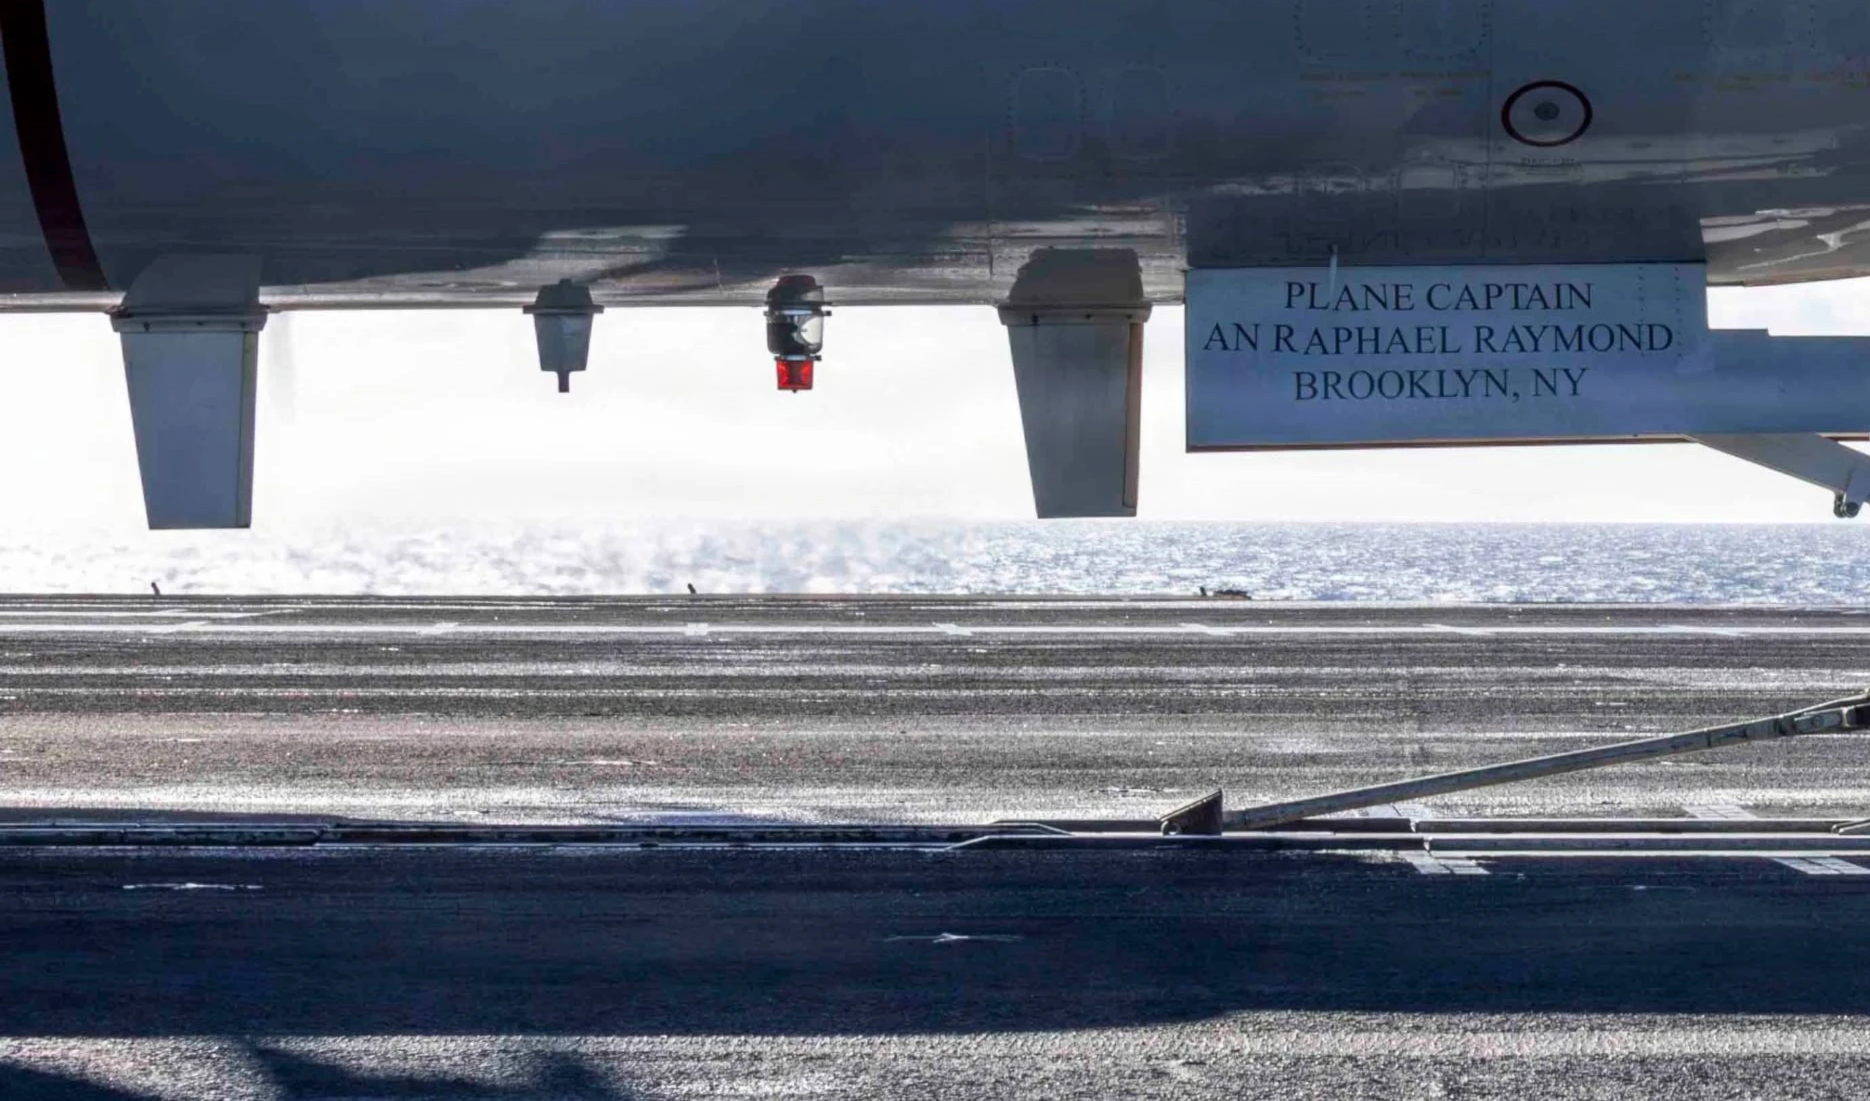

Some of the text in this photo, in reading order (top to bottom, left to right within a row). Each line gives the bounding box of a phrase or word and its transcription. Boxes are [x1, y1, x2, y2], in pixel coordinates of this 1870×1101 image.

[1284, 281, 1594, 312] PLANE CAPTAIN
[1203, 321, 1674, 356] AN RAPHAEL RAYMOND
[1294, 367, 1590, 404] BROOKLYN, NY
